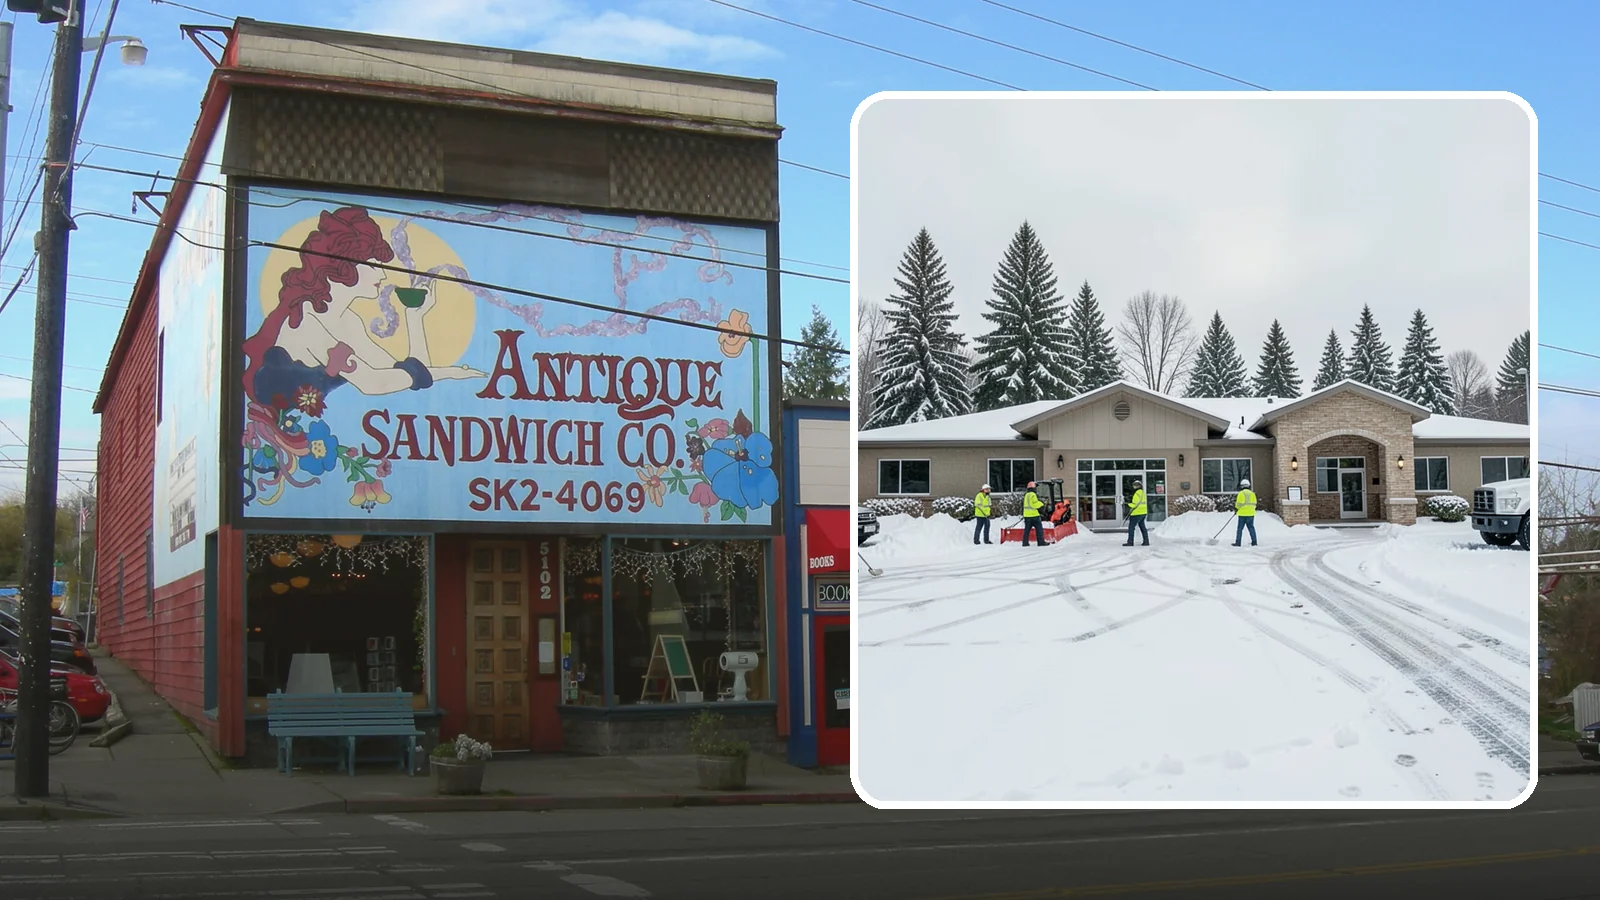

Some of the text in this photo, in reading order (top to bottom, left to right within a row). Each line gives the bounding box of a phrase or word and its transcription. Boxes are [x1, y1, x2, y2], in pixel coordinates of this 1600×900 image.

[475, 328, 723, 421] ANTIQUE
[361, 408, 685, 468] SANDWICH CO.
[468, 477, 645, 513] SK2-4069
[539, 541, 552, 600] 5102
[809, 555, 835, 569] BOOKS
